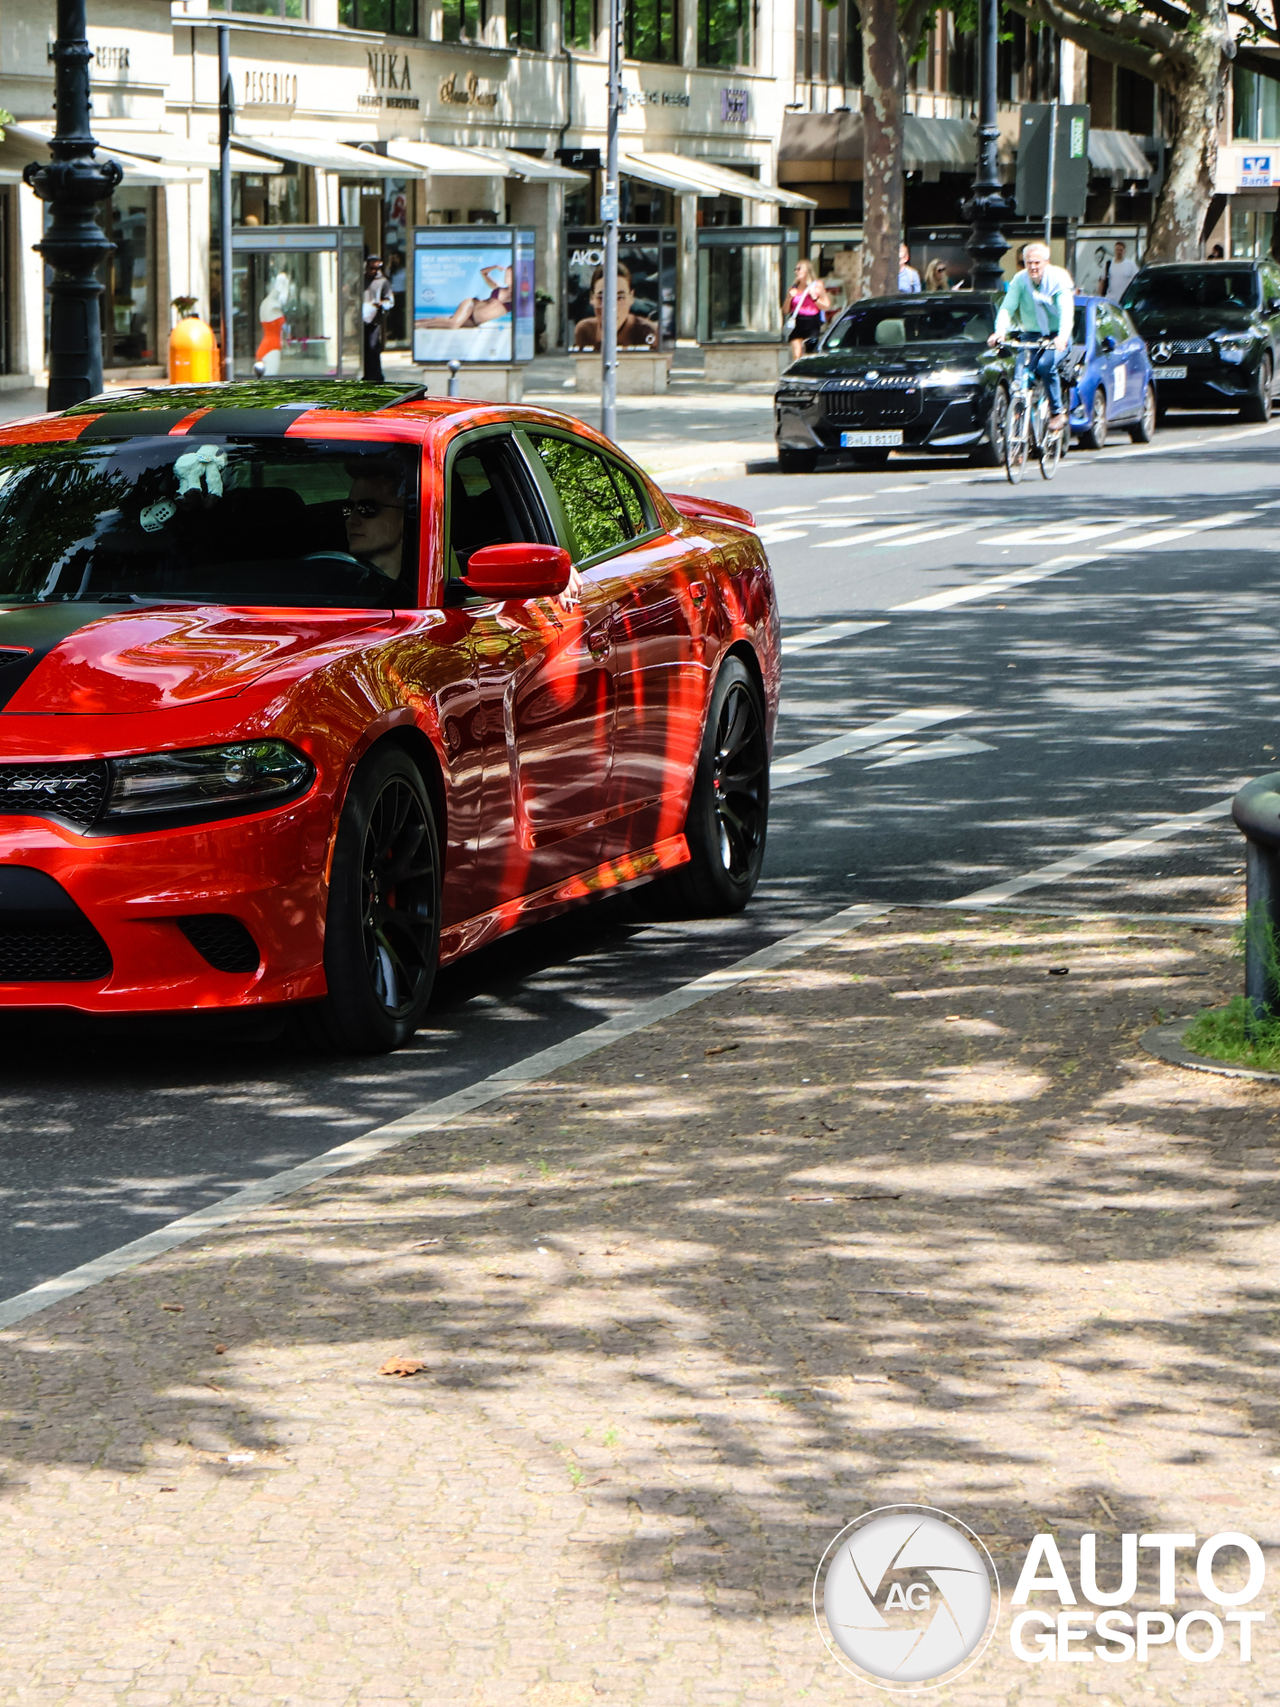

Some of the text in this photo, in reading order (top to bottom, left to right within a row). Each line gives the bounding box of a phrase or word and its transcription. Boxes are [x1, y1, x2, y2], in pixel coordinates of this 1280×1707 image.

[95, 46, 130, 68] REITER
[366, 51, 412, 91] NIKA
[245, 71, 297, 104] PESERICO
[1242, 175, 1270, 186] Bank
[6, 778, 88, 795] SRT
